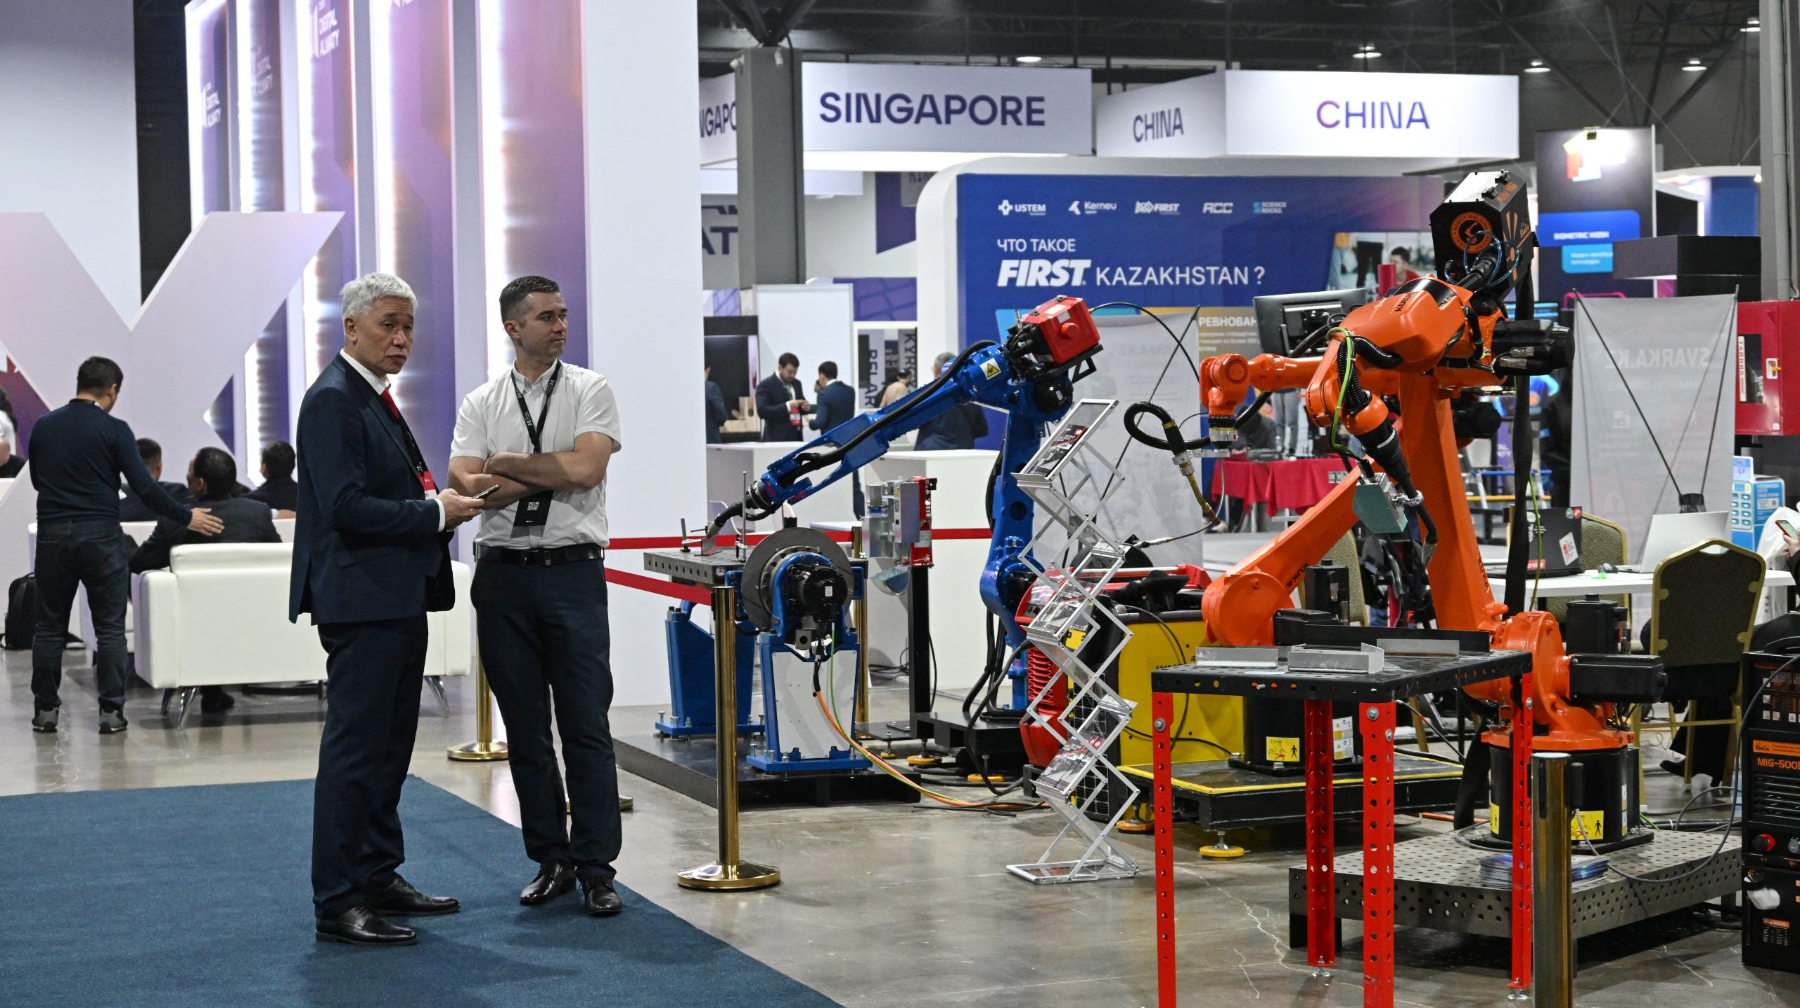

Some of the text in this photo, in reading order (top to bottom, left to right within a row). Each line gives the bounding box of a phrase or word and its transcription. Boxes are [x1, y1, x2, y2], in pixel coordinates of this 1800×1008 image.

[819, 92, 1046, 127] SINGAPORE
[1316, 100, 1430, 130] CHINA
[1132, 108, 1184, 143] CHINA
[1014, 203, 1047, 213] USTEM
[997, 238, 1077, 252] ЧТО ТАКОЕ
[997, 258, 1092, 287] FIRST
[1096, 266, 1249, 286] KAZAKHSTAN
